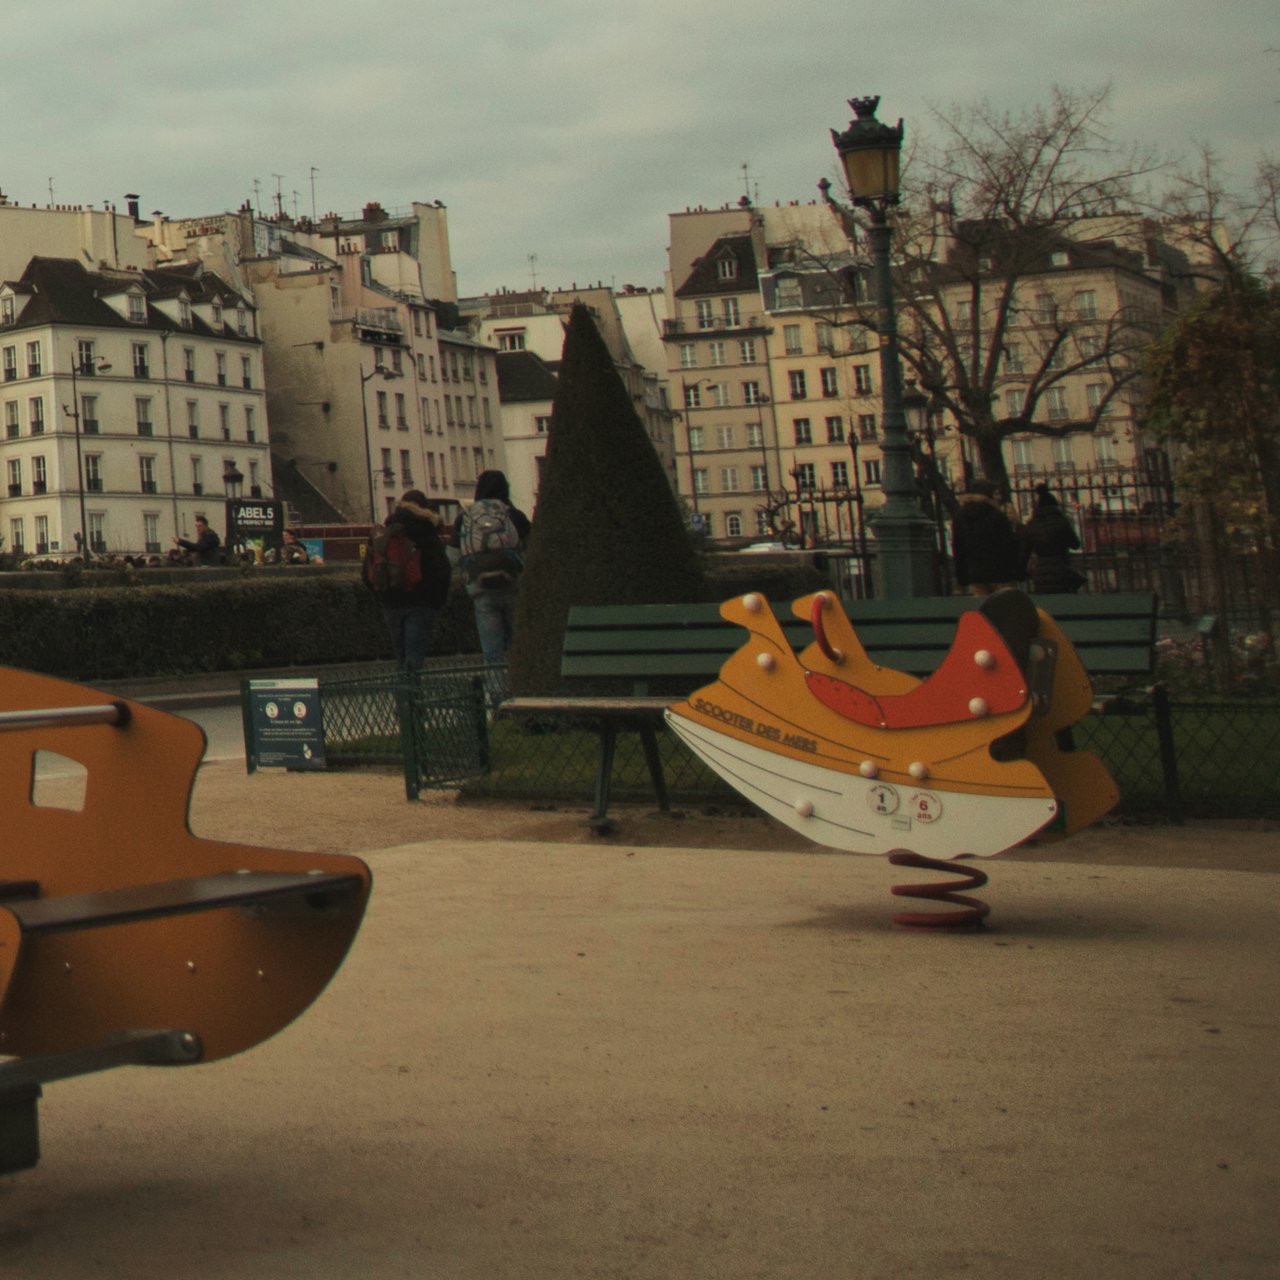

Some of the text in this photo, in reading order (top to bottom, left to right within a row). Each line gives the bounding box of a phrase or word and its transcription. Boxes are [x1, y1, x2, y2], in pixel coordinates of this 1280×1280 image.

[233, 507, 274, 519] ABEL 5
[694, 698, 818, 753] SCOOTER DES MERS
[879, 793, 885, 803] 1
[919, 800, 928, 811] 6
[917, 812, 932, 820] ans
